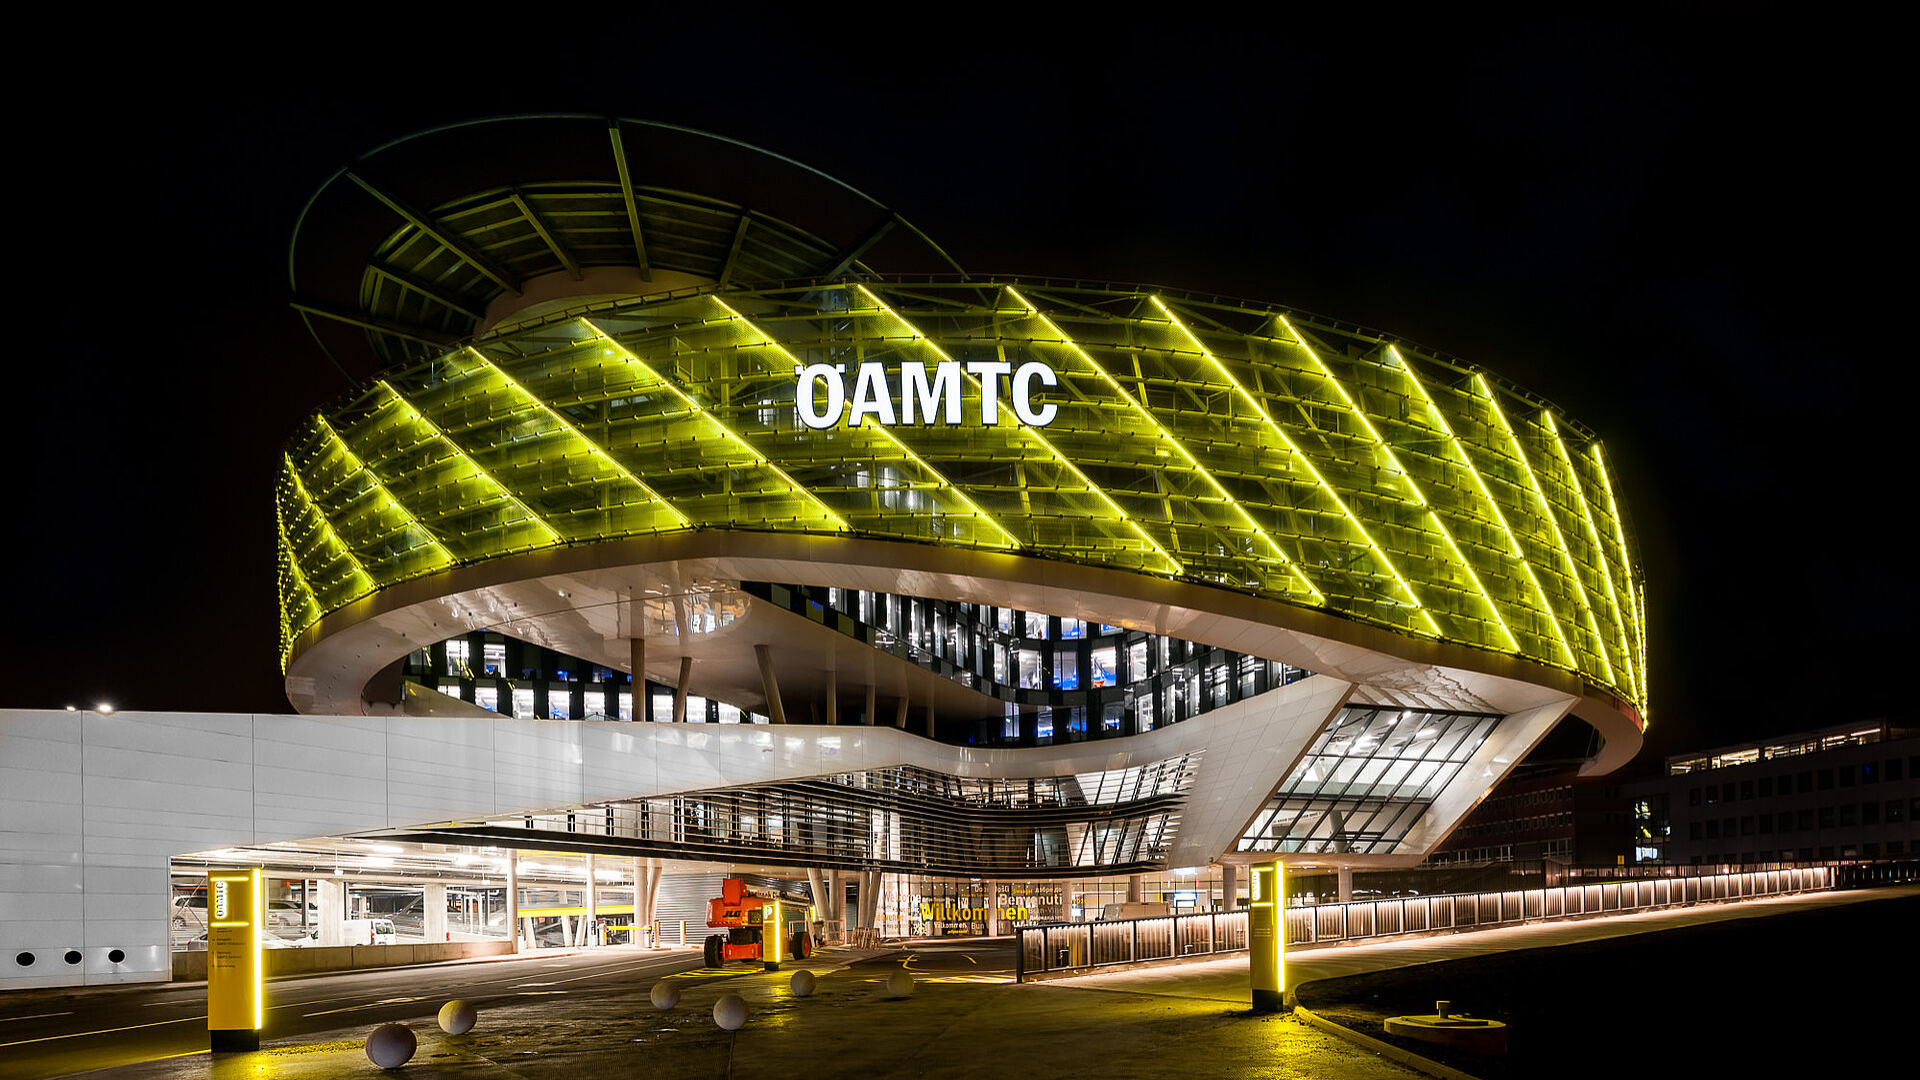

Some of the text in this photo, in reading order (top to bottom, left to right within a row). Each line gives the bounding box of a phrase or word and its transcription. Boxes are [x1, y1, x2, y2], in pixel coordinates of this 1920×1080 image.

[794, 361, 1059, 429] ÖAMTC
[999, 893, 1062, 905] Benvenuti
[722, 910, 742, 918] JLG
[764, 906, 773, 919] P
